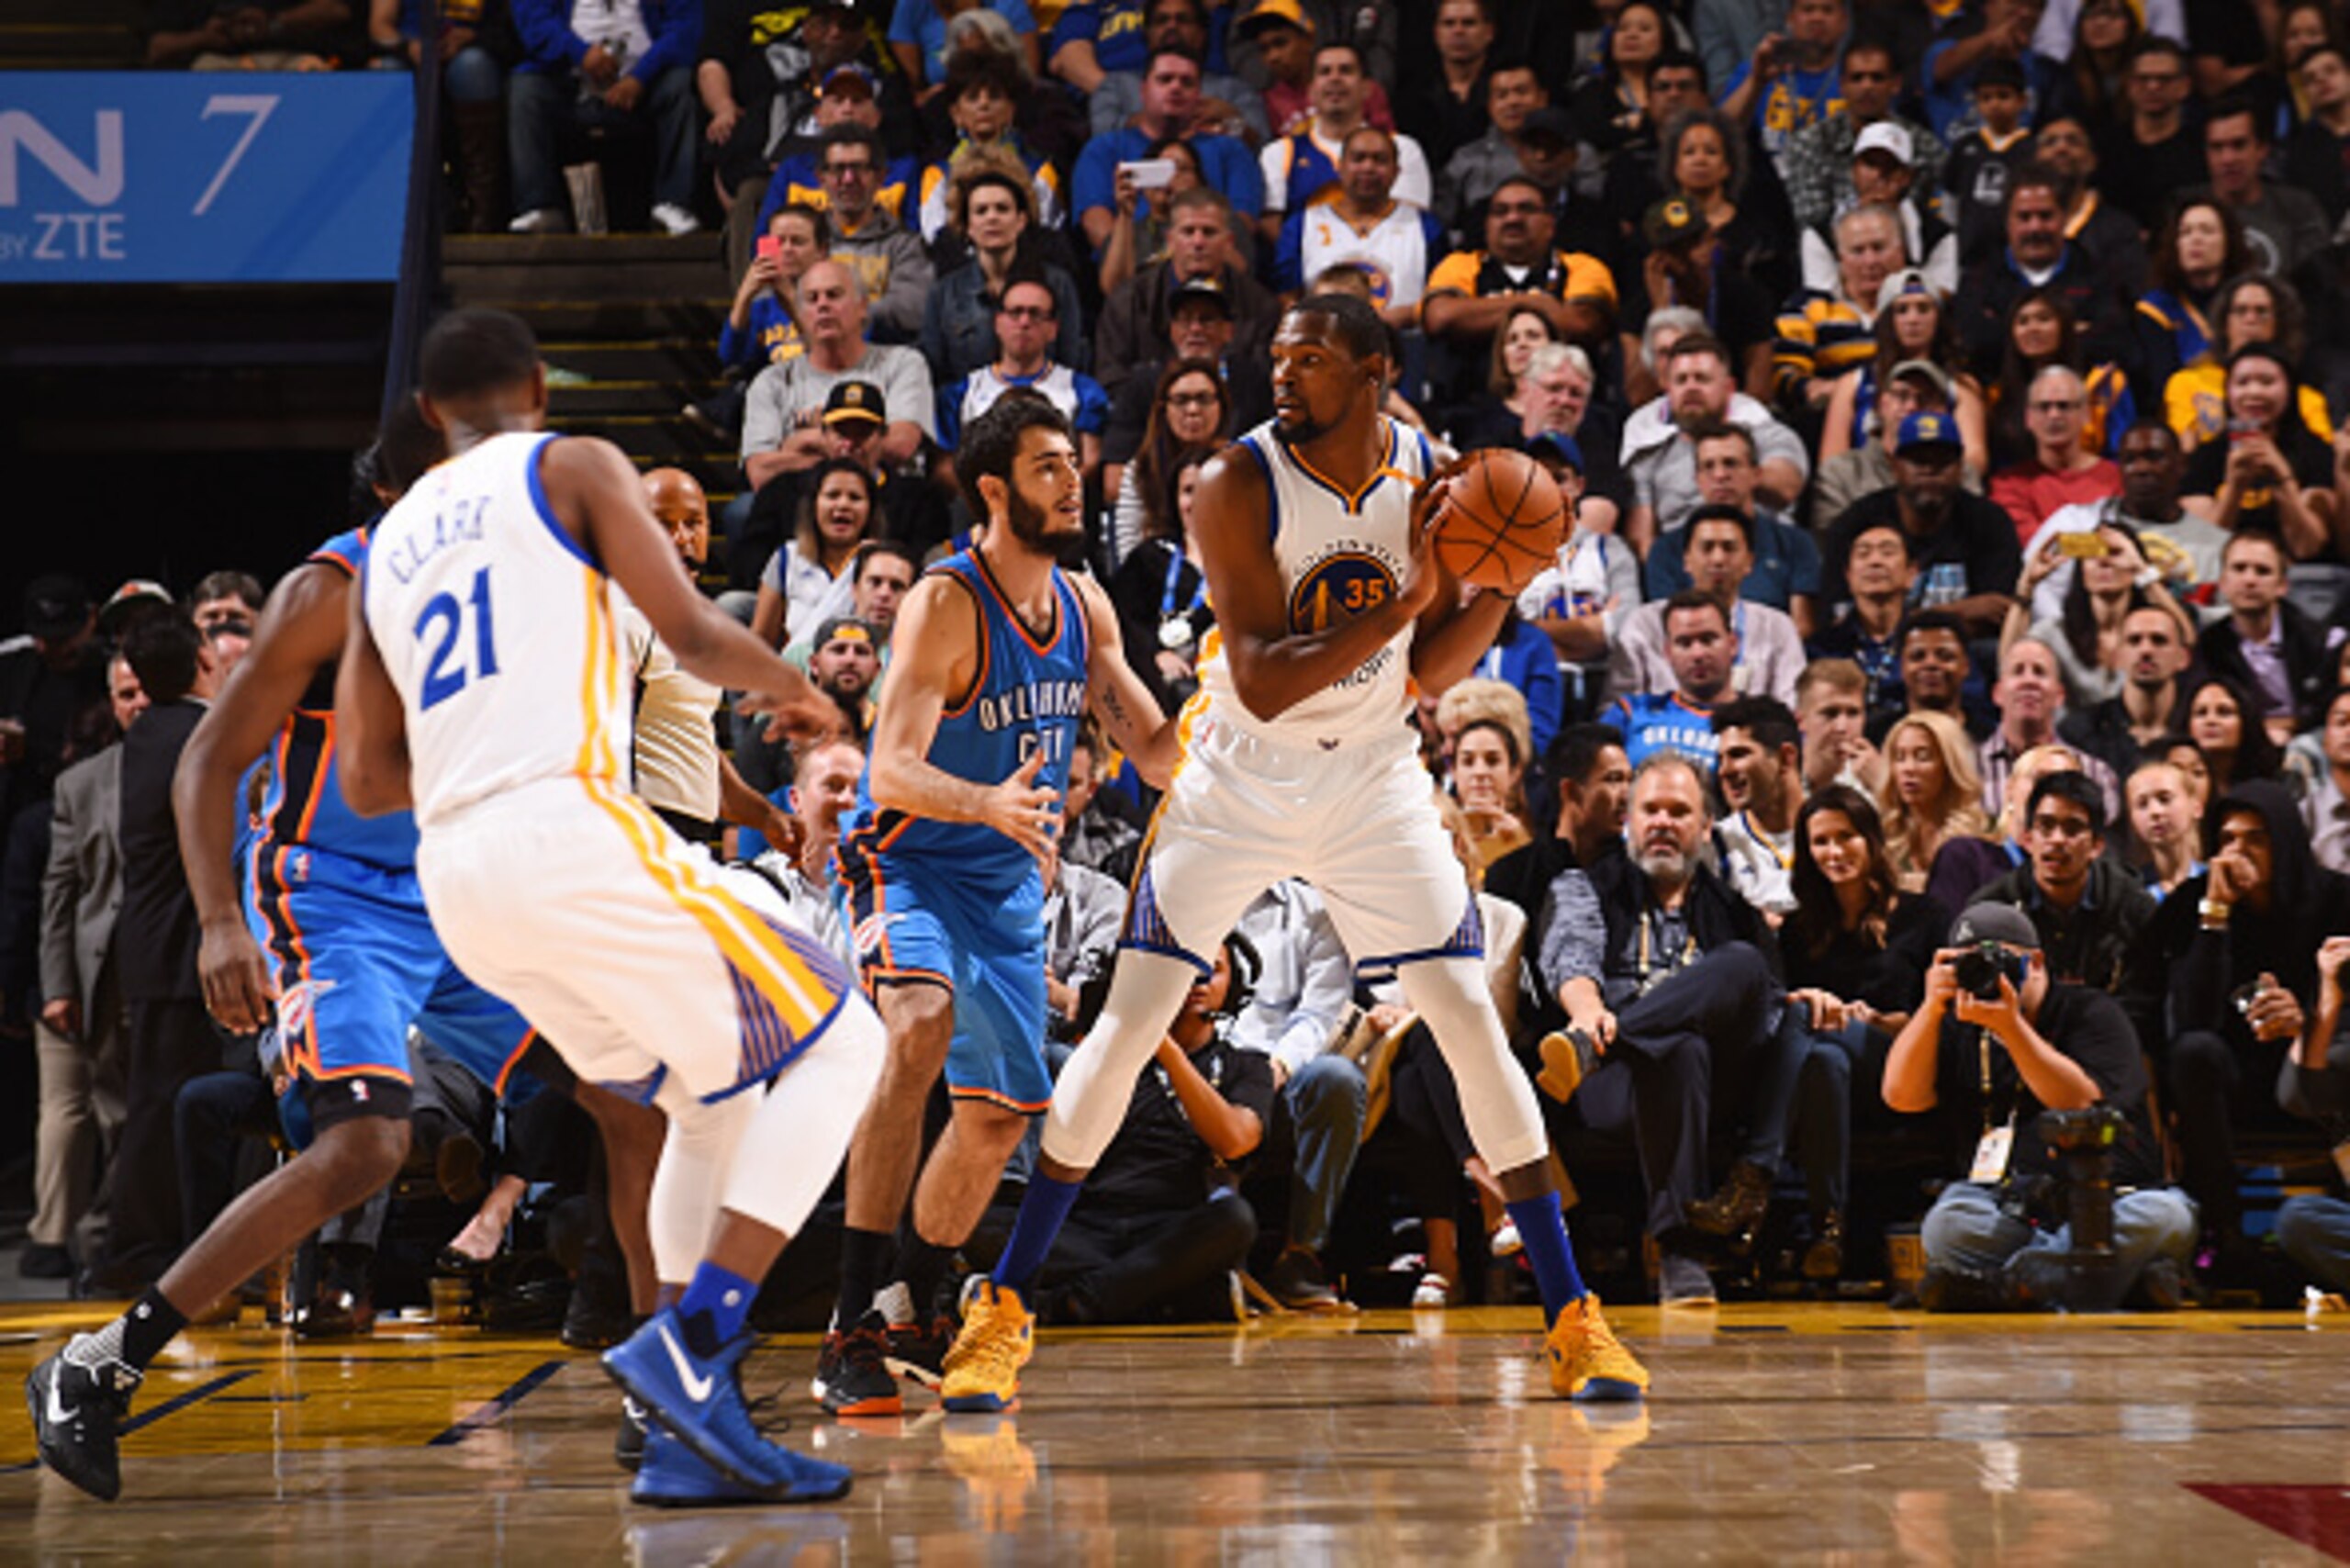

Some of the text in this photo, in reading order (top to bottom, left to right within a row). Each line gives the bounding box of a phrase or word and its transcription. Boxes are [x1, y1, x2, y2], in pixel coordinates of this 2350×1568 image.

[192, 95, 281, 216] 7
[33, 213, 126, 259] ZTE
[1344, 577, 1386, 610] 35
[413, 564, 500, 711] 21
